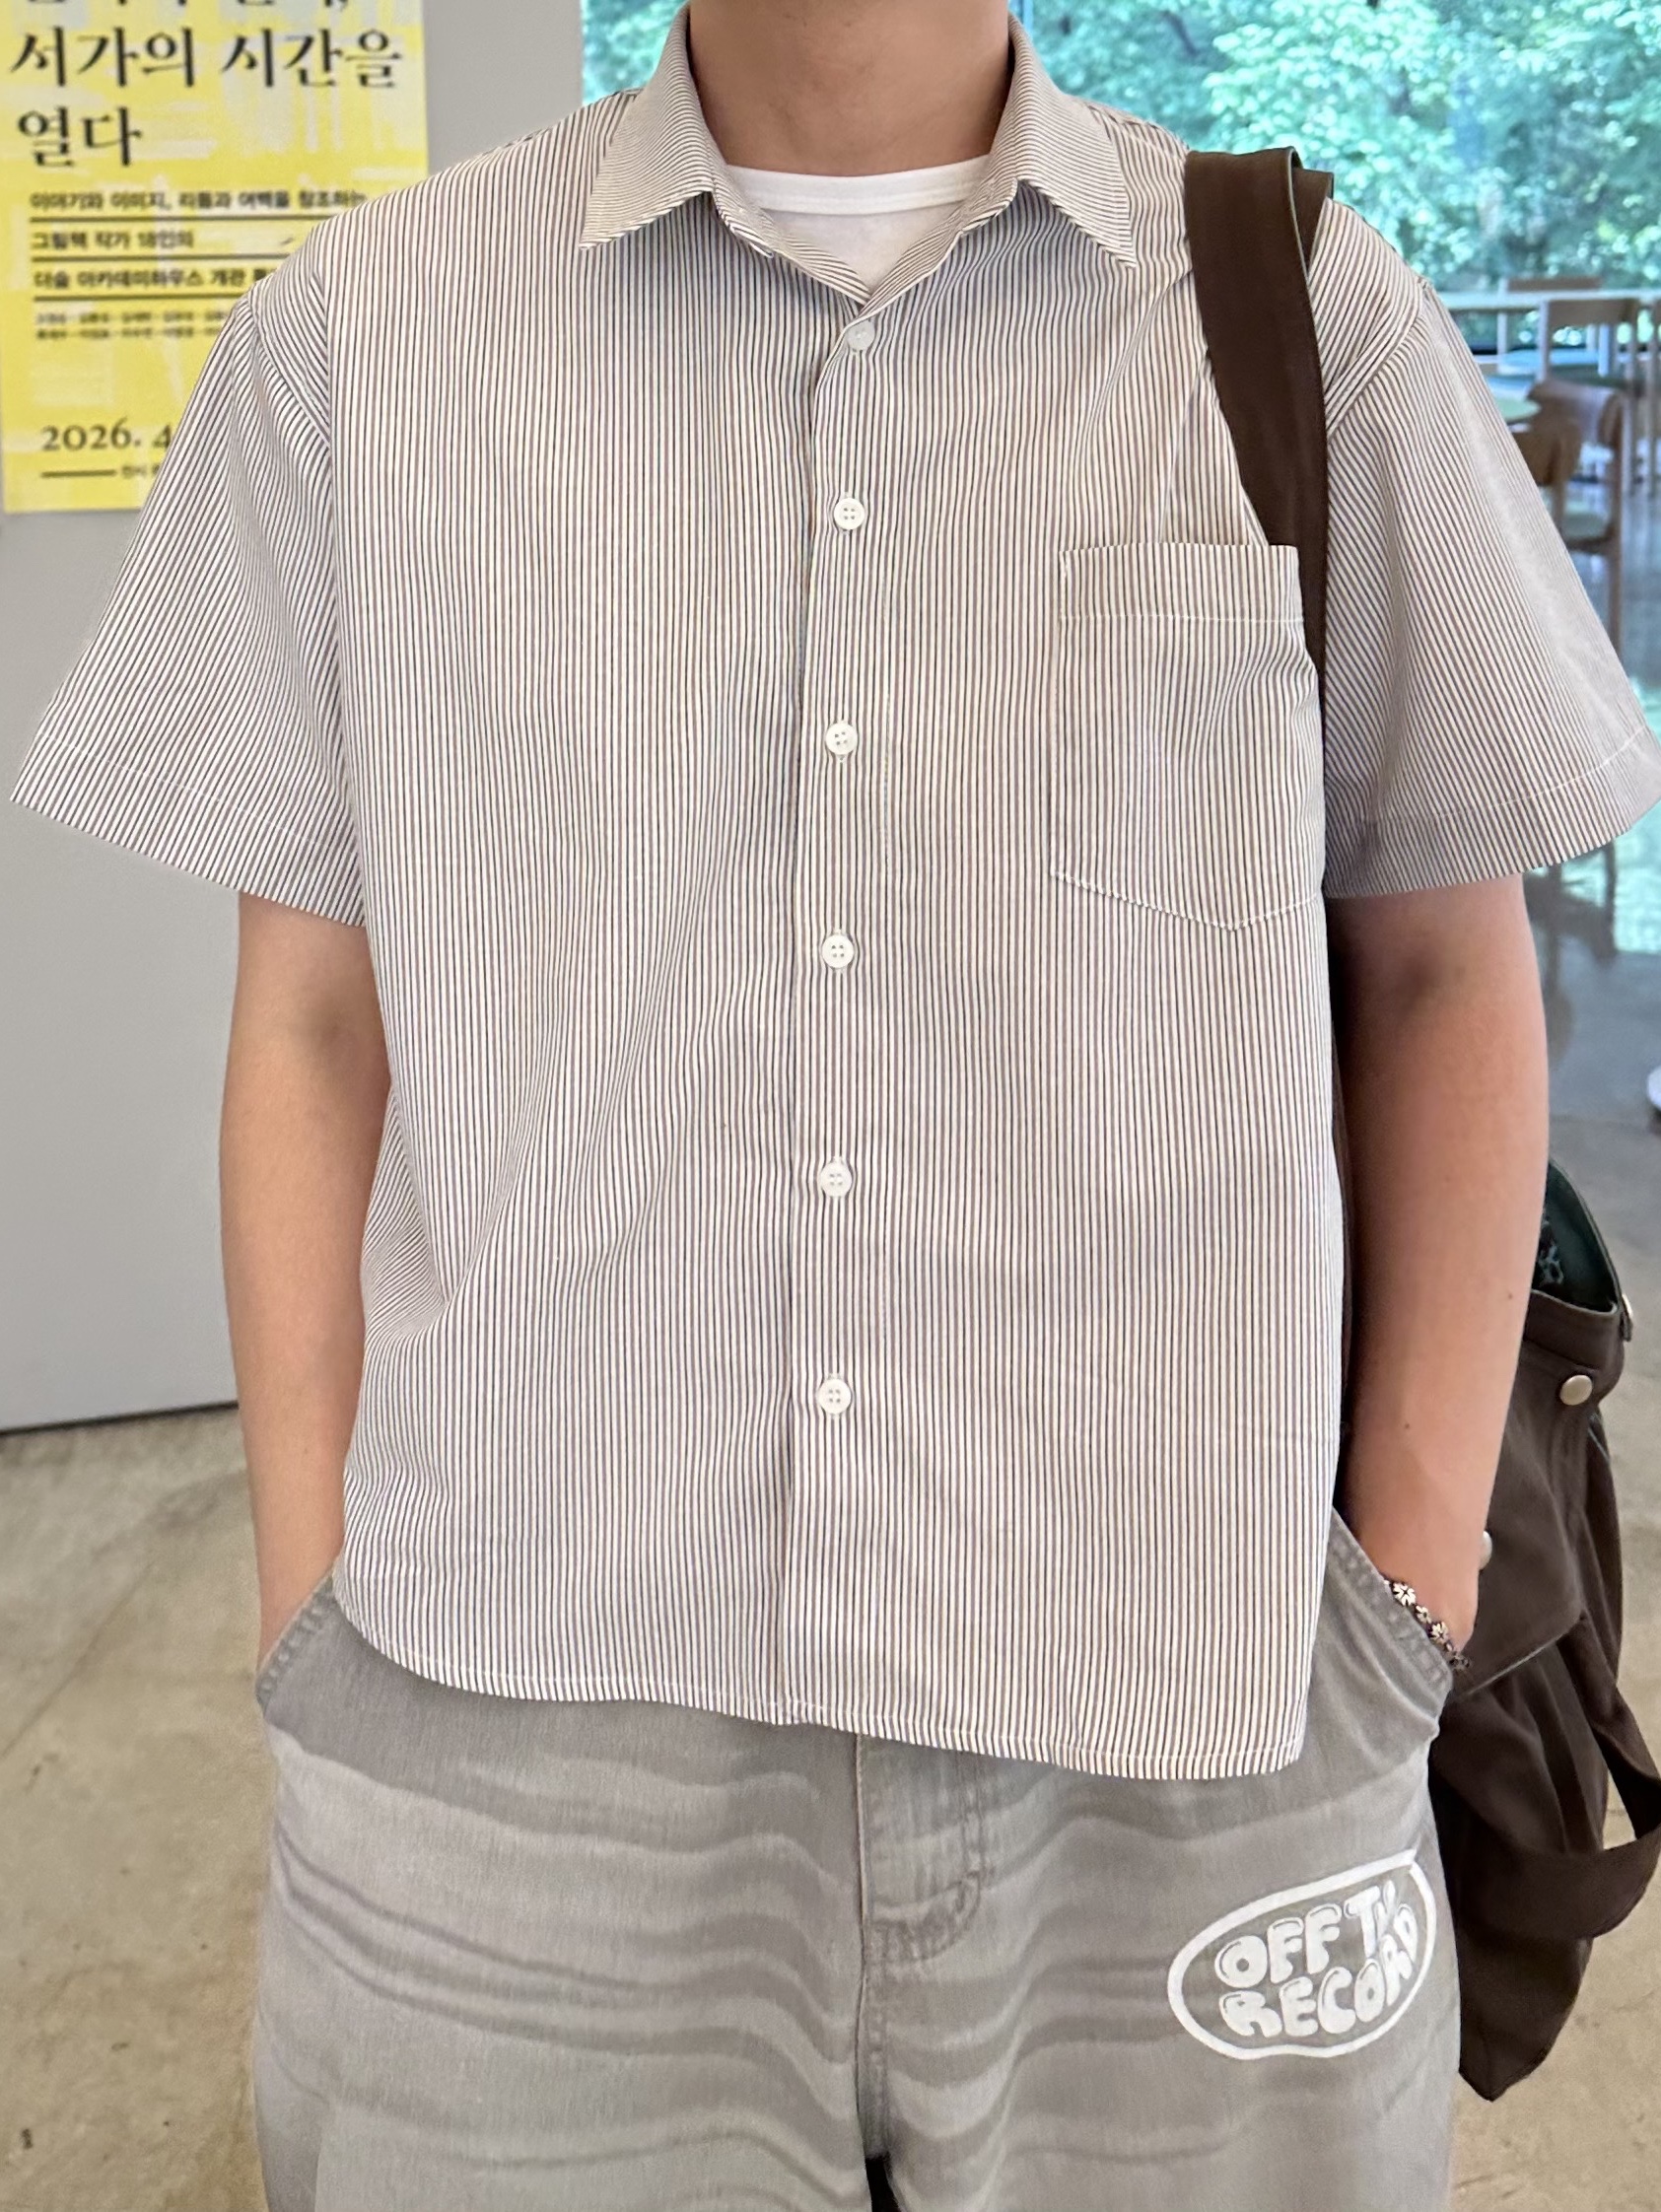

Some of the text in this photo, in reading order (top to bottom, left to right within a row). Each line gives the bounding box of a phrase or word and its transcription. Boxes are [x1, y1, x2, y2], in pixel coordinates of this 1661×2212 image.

[10, 26, 402, 89] 서가의 시간을
[18, 105, 141, 168] 열다
[42, 416, 141, 450] 2026.
[1214, 1903, 1342, 1988] OFF
